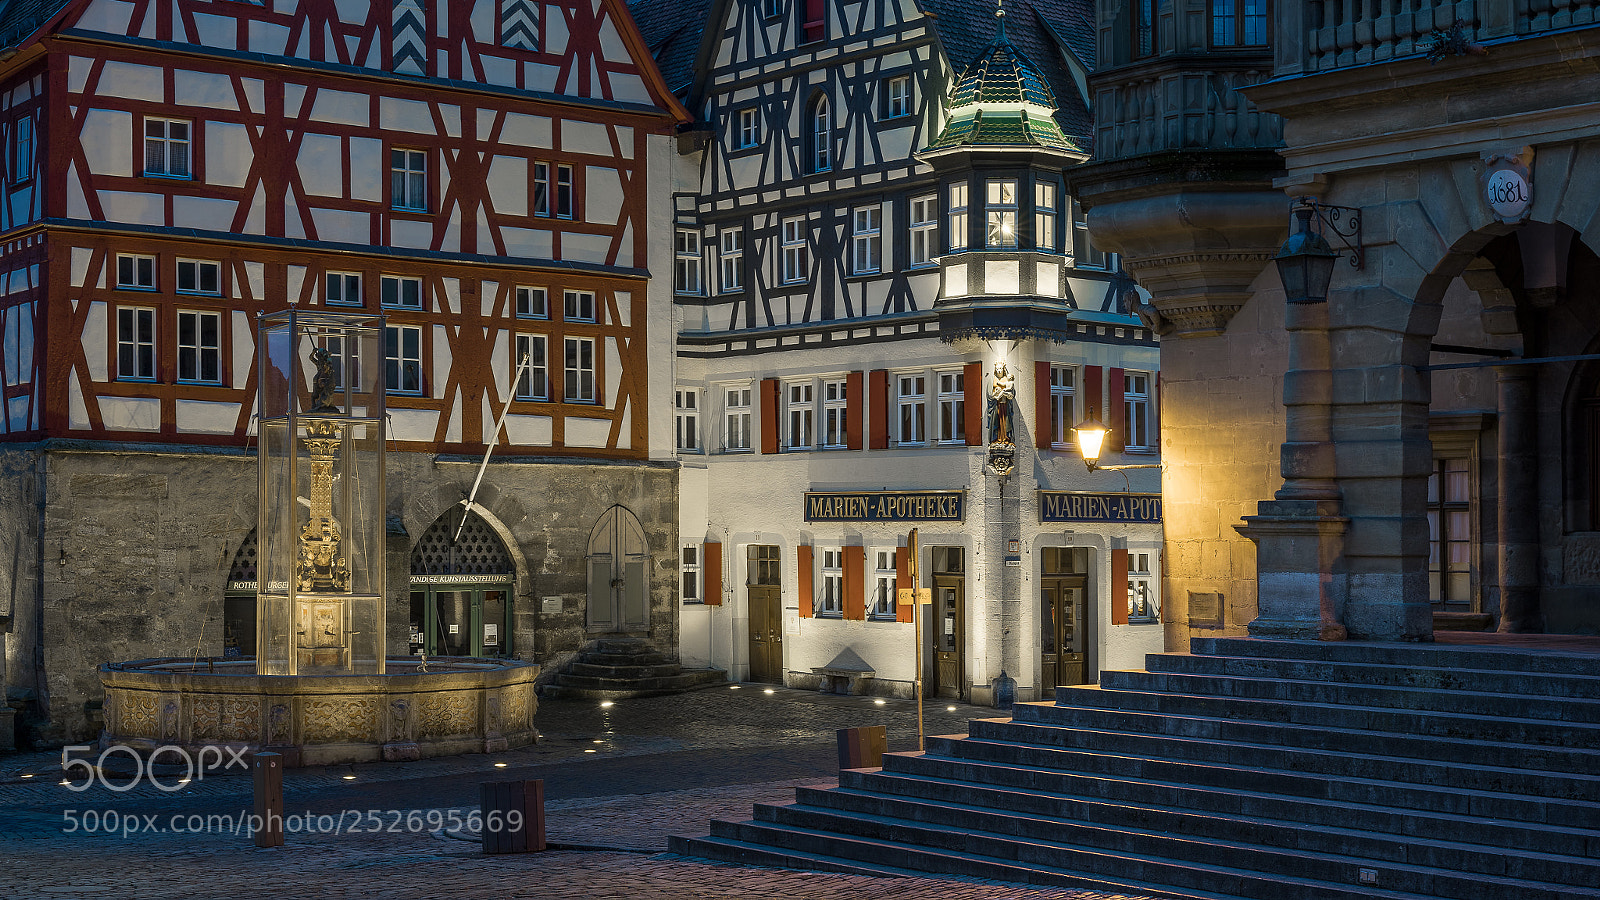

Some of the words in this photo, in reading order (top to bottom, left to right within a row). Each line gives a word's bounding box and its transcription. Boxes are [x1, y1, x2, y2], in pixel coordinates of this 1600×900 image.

[1490, 177, 1529, 205] 1681
[810, 495, 959, 519] MARIEN-APOTHEKE
[1045, 495, 1161, 520] MARIEN-APOT
